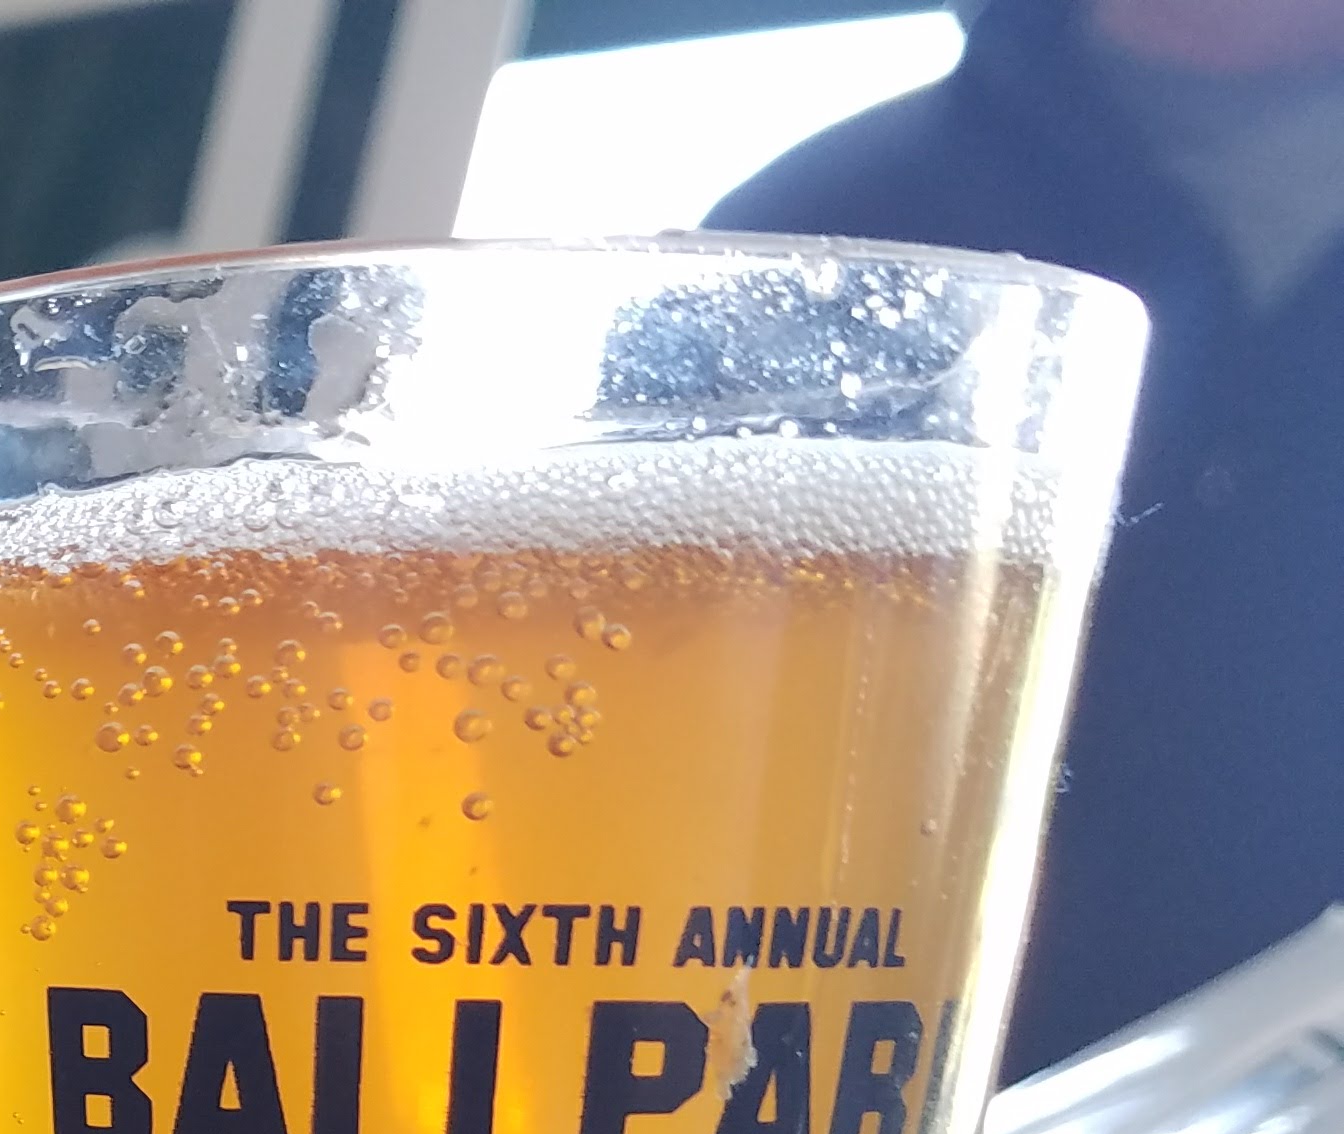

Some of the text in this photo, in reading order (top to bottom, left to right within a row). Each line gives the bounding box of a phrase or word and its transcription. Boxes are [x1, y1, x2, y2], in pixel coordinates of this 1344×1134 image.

[226, 899, 906, 970] THE SIXTH ANNUAL
